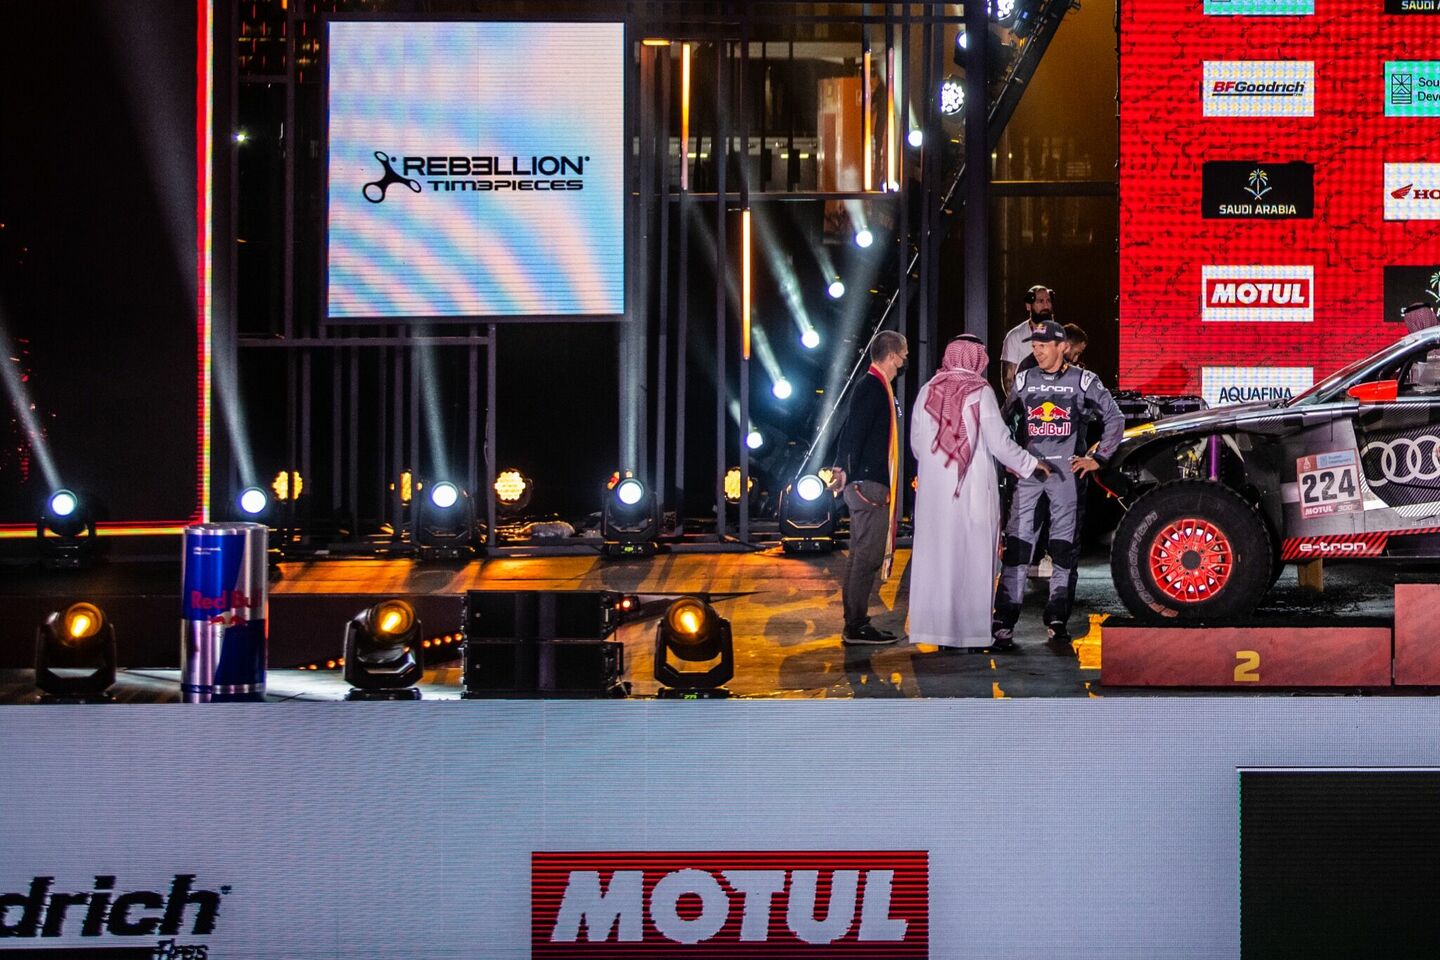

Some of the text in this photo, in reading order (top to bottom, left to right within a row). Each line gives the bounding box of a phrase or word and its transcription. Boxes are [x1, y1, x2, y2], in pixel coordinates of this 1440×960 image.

[1401, 0, 1434, 10] SAUDI
[1213, 81, 1305, 93] BFGoodrich
[1219, 204, 1297, 215] SAUDI ARABIA
[1211, 283, 1305, 304] MOTUL
[1218, 386, 1293, 403] AQUAFINA
[1047, 422, 1071, 436] Bull
[1302, 468, 1356, 503] 224
[1305, 505, 1333, 515] MOTUL
[1299, 541, 1367, 552] e-tron
[1233, 650, 1260, 682] 2
[551, 868, 909, 944] MOTUL
